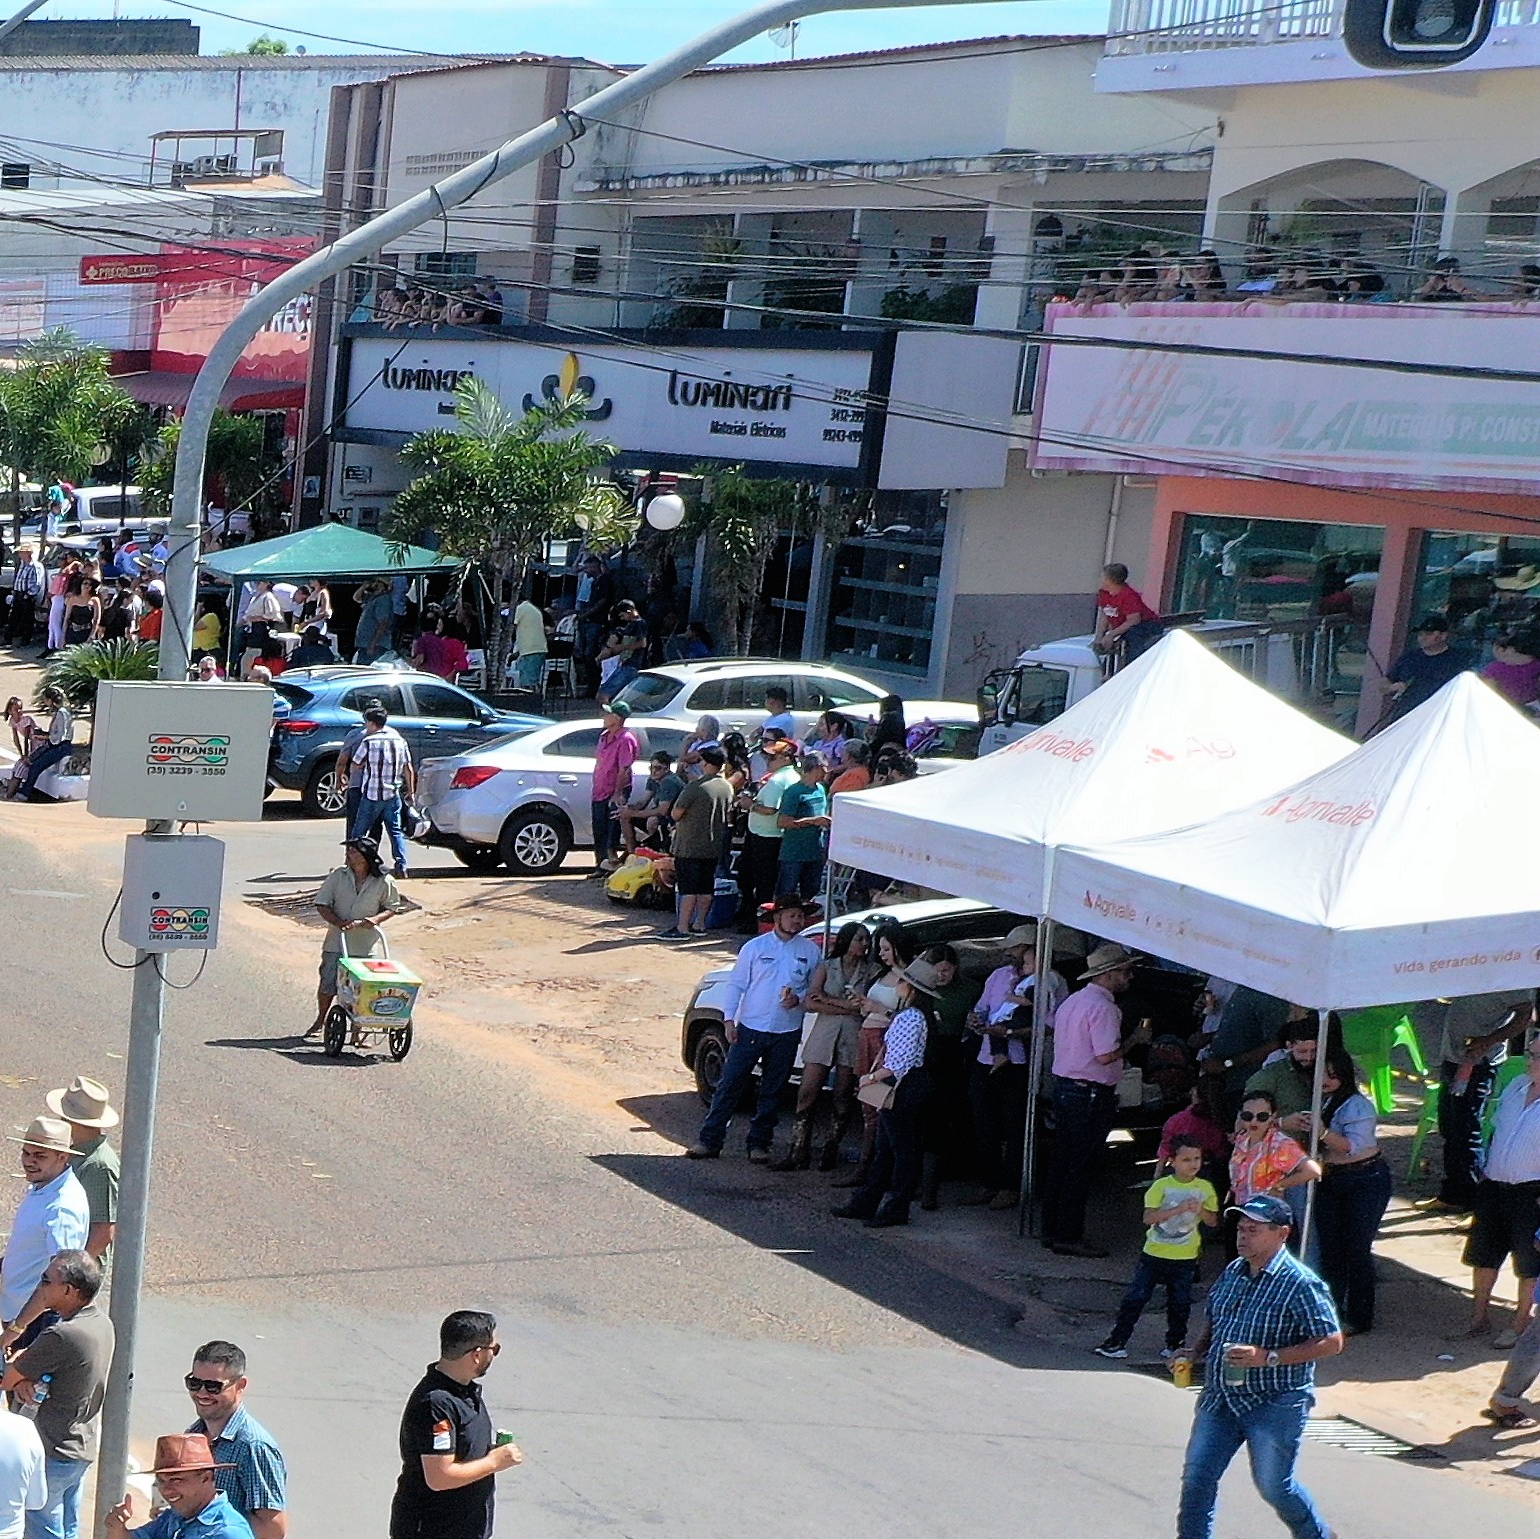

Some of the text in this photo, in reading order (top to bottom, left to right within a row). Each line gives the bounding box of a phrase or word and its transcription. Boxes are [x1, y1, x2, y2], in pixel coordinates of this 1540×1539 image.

[150, 745, 227, 756] CONTRANSIN
[1392, 948, 1522, 975] Vida gerando vida
